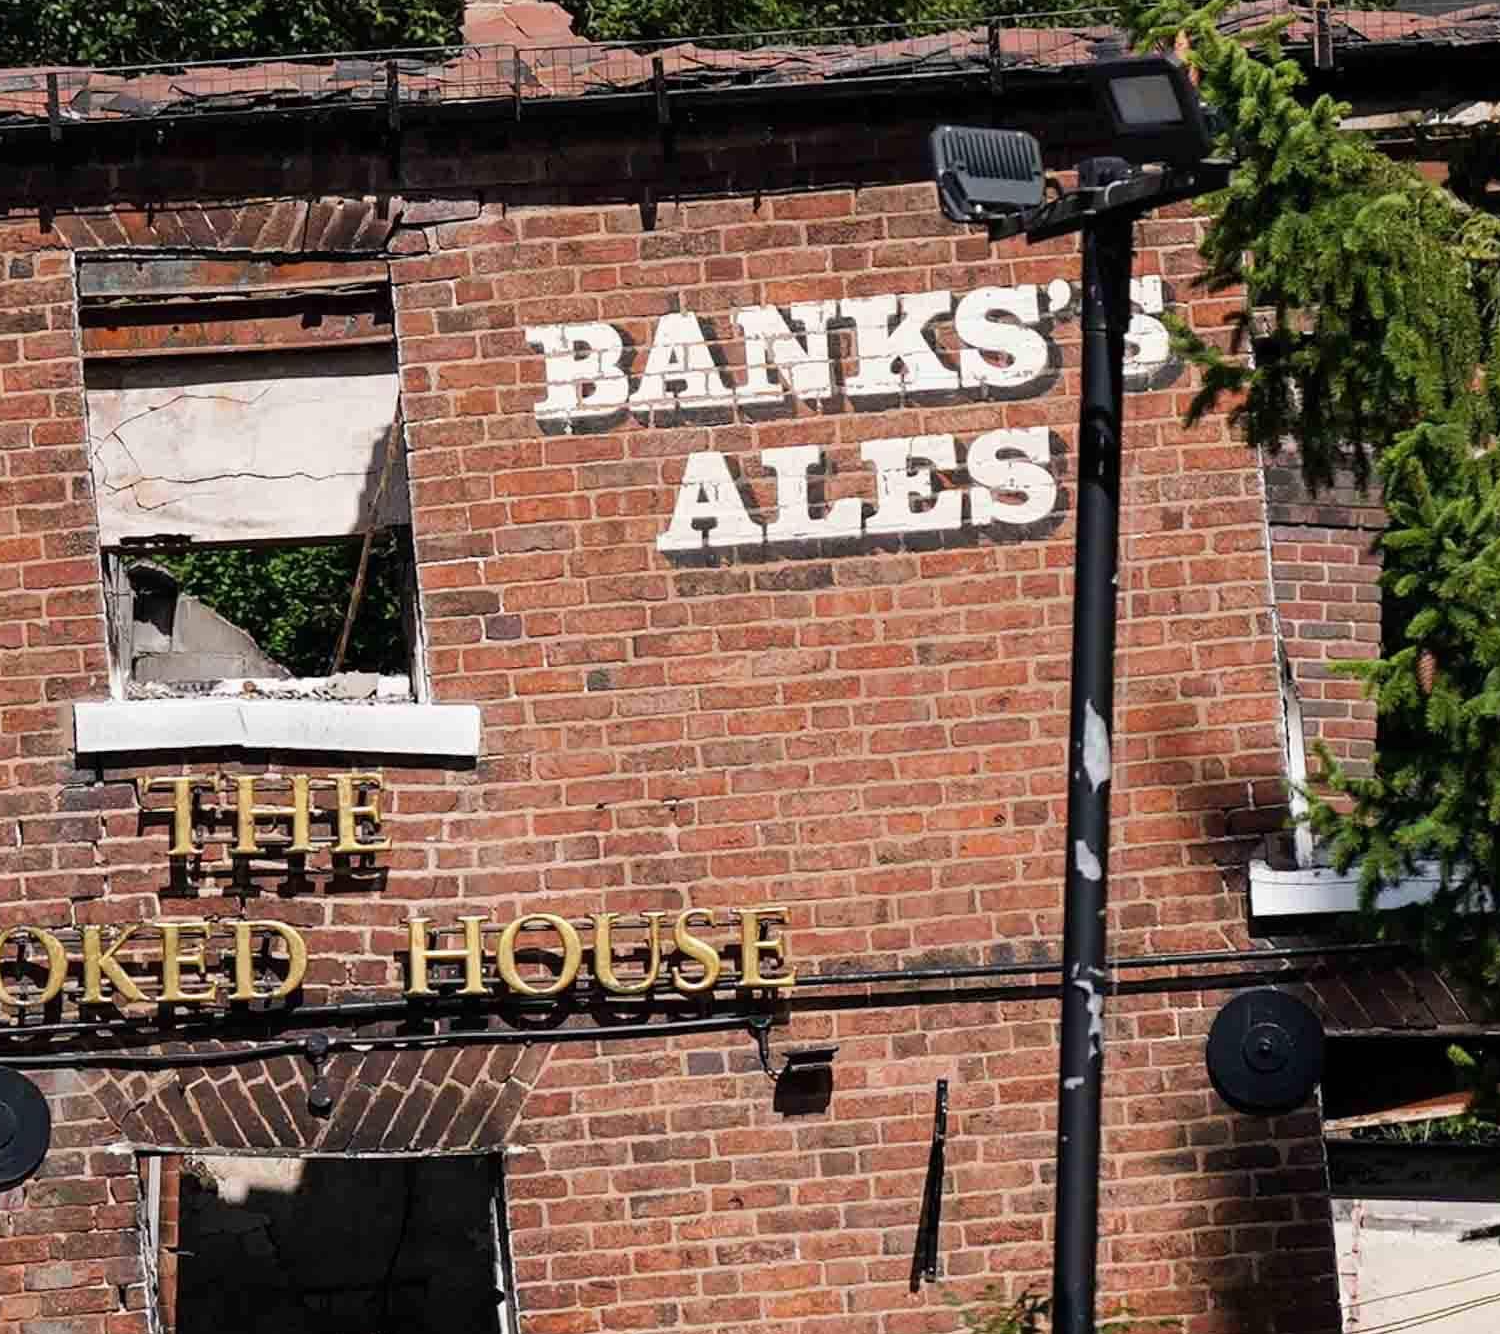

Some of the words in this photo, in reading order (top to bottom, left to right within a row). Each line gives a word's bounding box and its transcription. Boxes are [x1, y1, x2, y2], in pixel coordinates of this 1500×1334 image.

[657, 426, 1058, 552] ALES
[138, 772, 394, 857] THE
[403, 905, 796, 998] HOUSE
